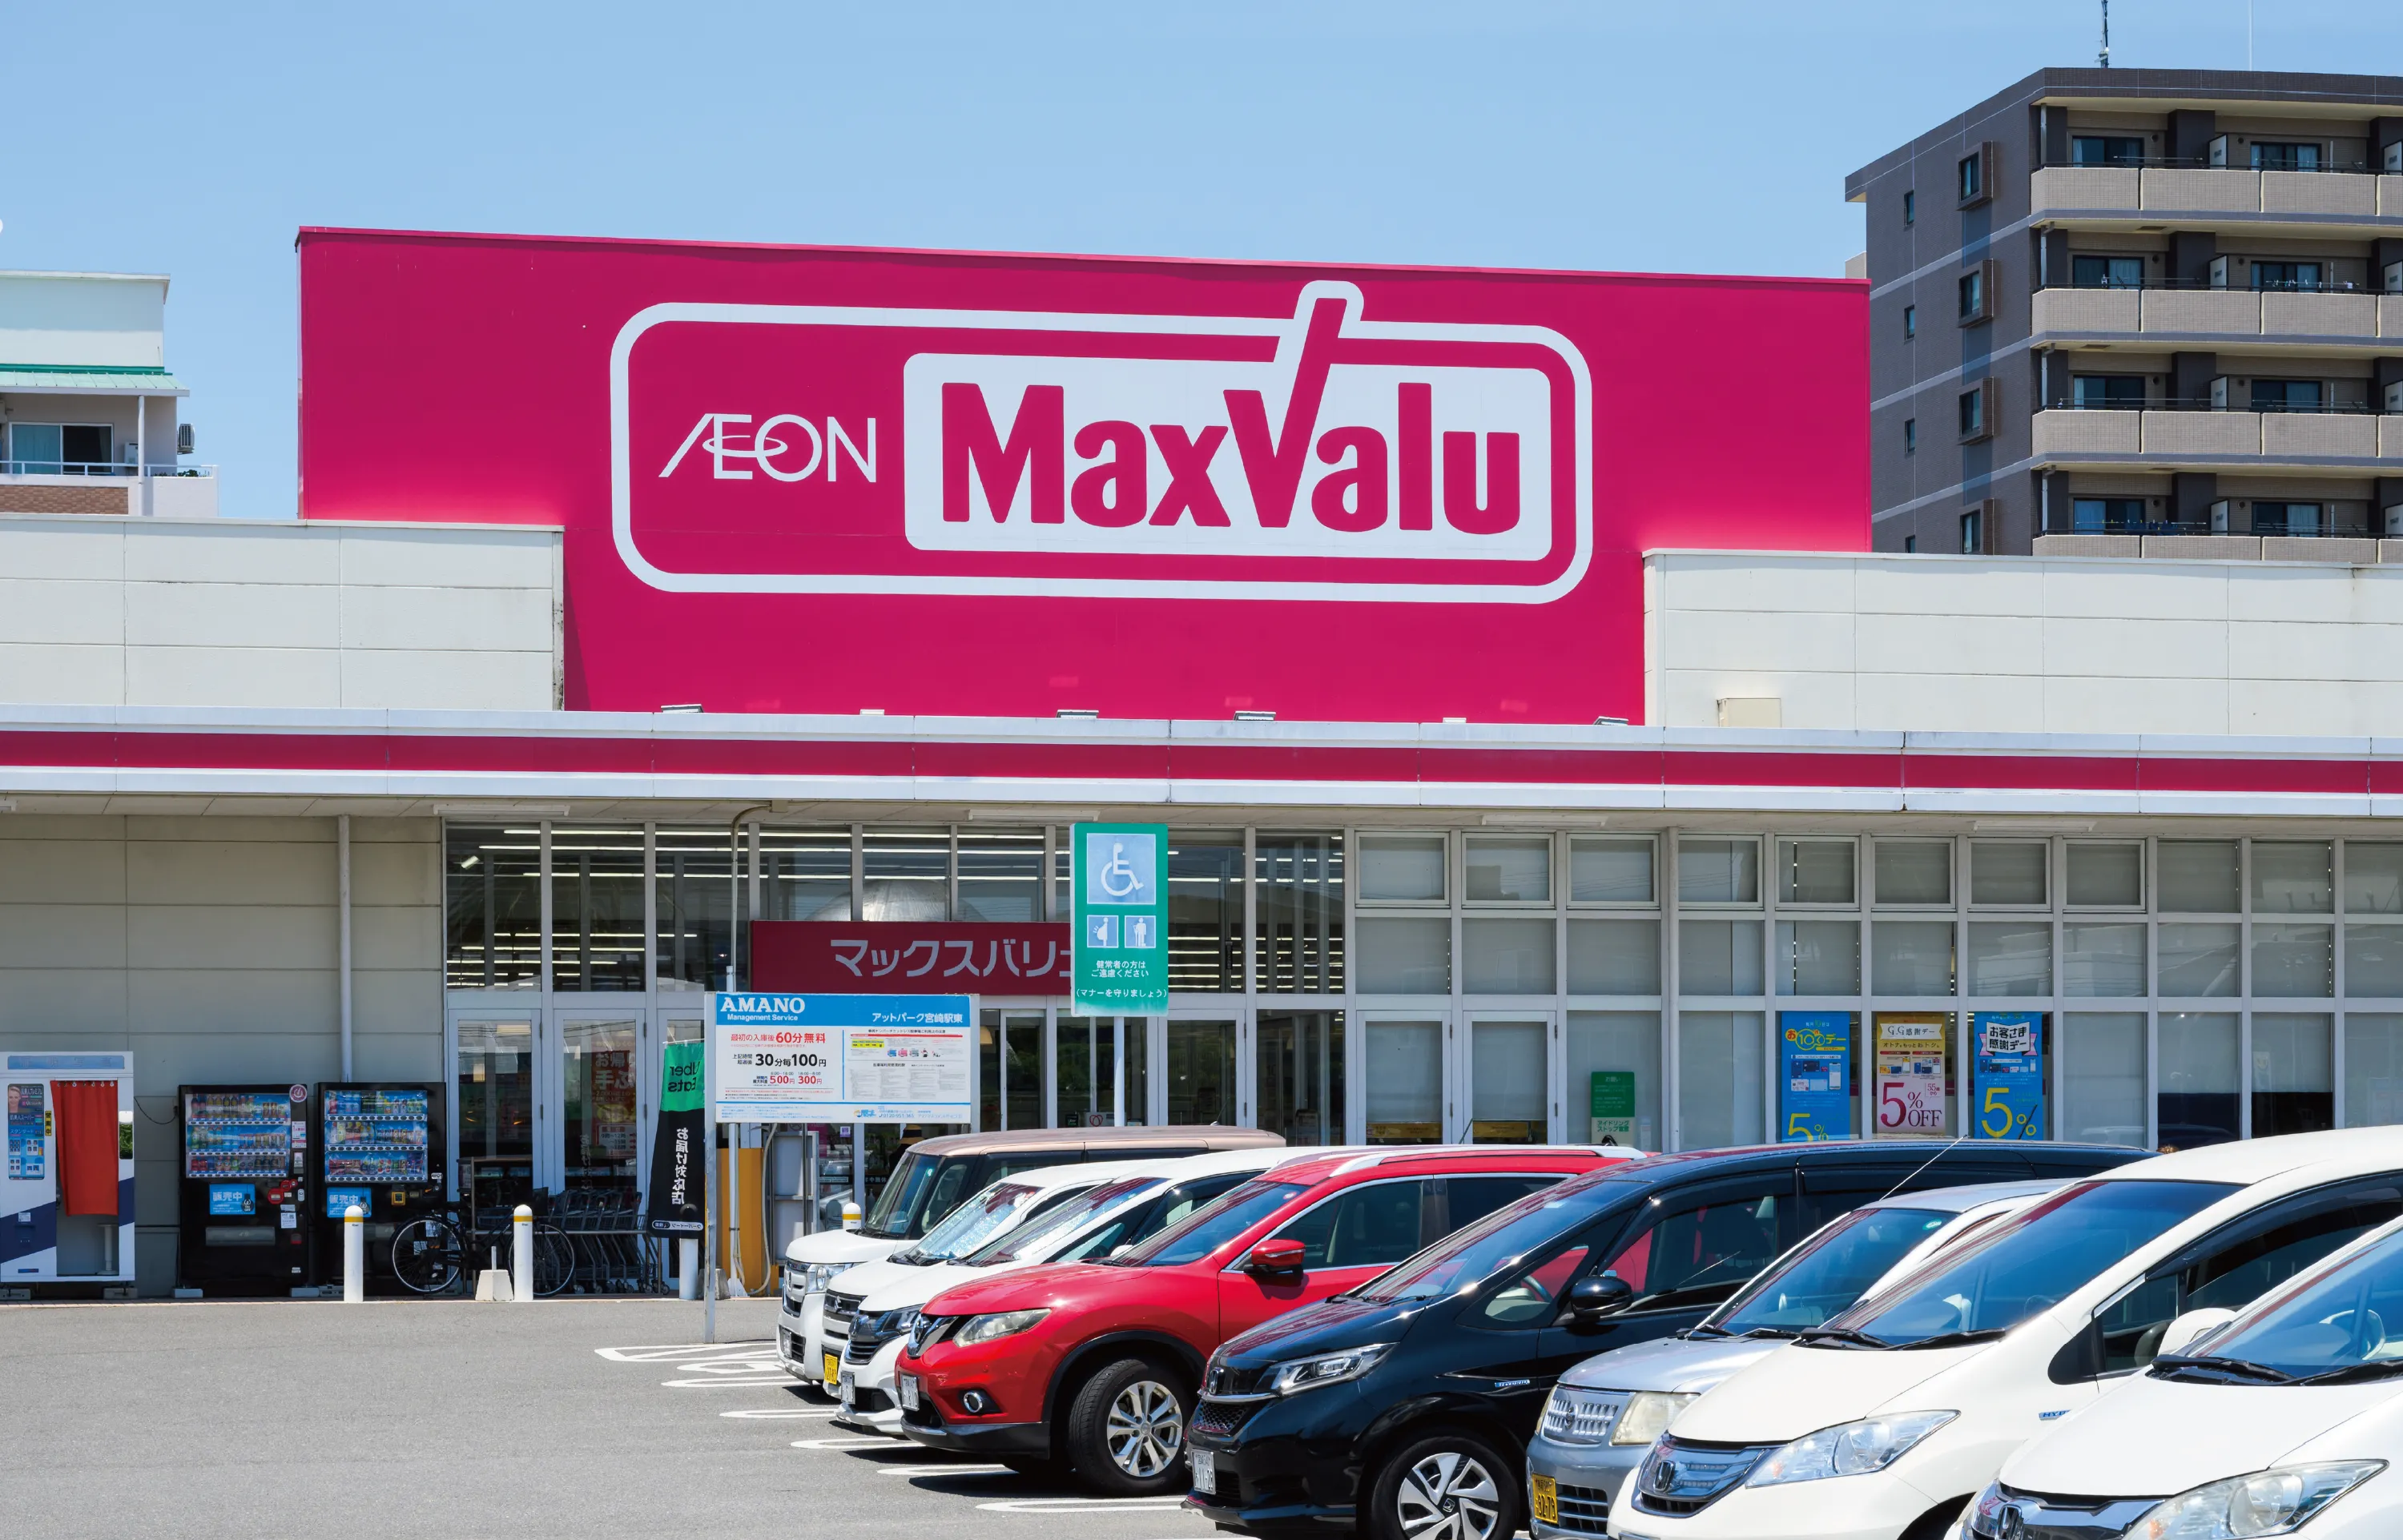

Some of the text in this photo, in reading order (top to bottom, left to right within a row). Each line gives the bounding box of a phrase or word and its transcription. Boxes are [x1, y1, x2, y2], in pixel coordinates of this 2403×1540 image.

[941, 297, 1521, 535] MaxValu
[1096, 960, 1145, 969] 健常者の方は
[1091, 969, 1149, 978] ご遠慮ください
[720, 997, 806, 1014] AMANO
[727, 1014, 771, 1022] Management
[872, 1012, 963, 1023] アットパーク宮崎駅東
[1989, 1026, 2027, 1039] お客さま
[1989, 1039, 2027, 1051] 感謝デー
[770, 1076, 823, 1084] 500円 300円
[1908, 1109, 1942, 1128] OFF
[212, 1192, 243, 1201] 販売中
[329, 1194, 359, 1204] 販売中
[2043, 1409, 2070, 1417] HYB
